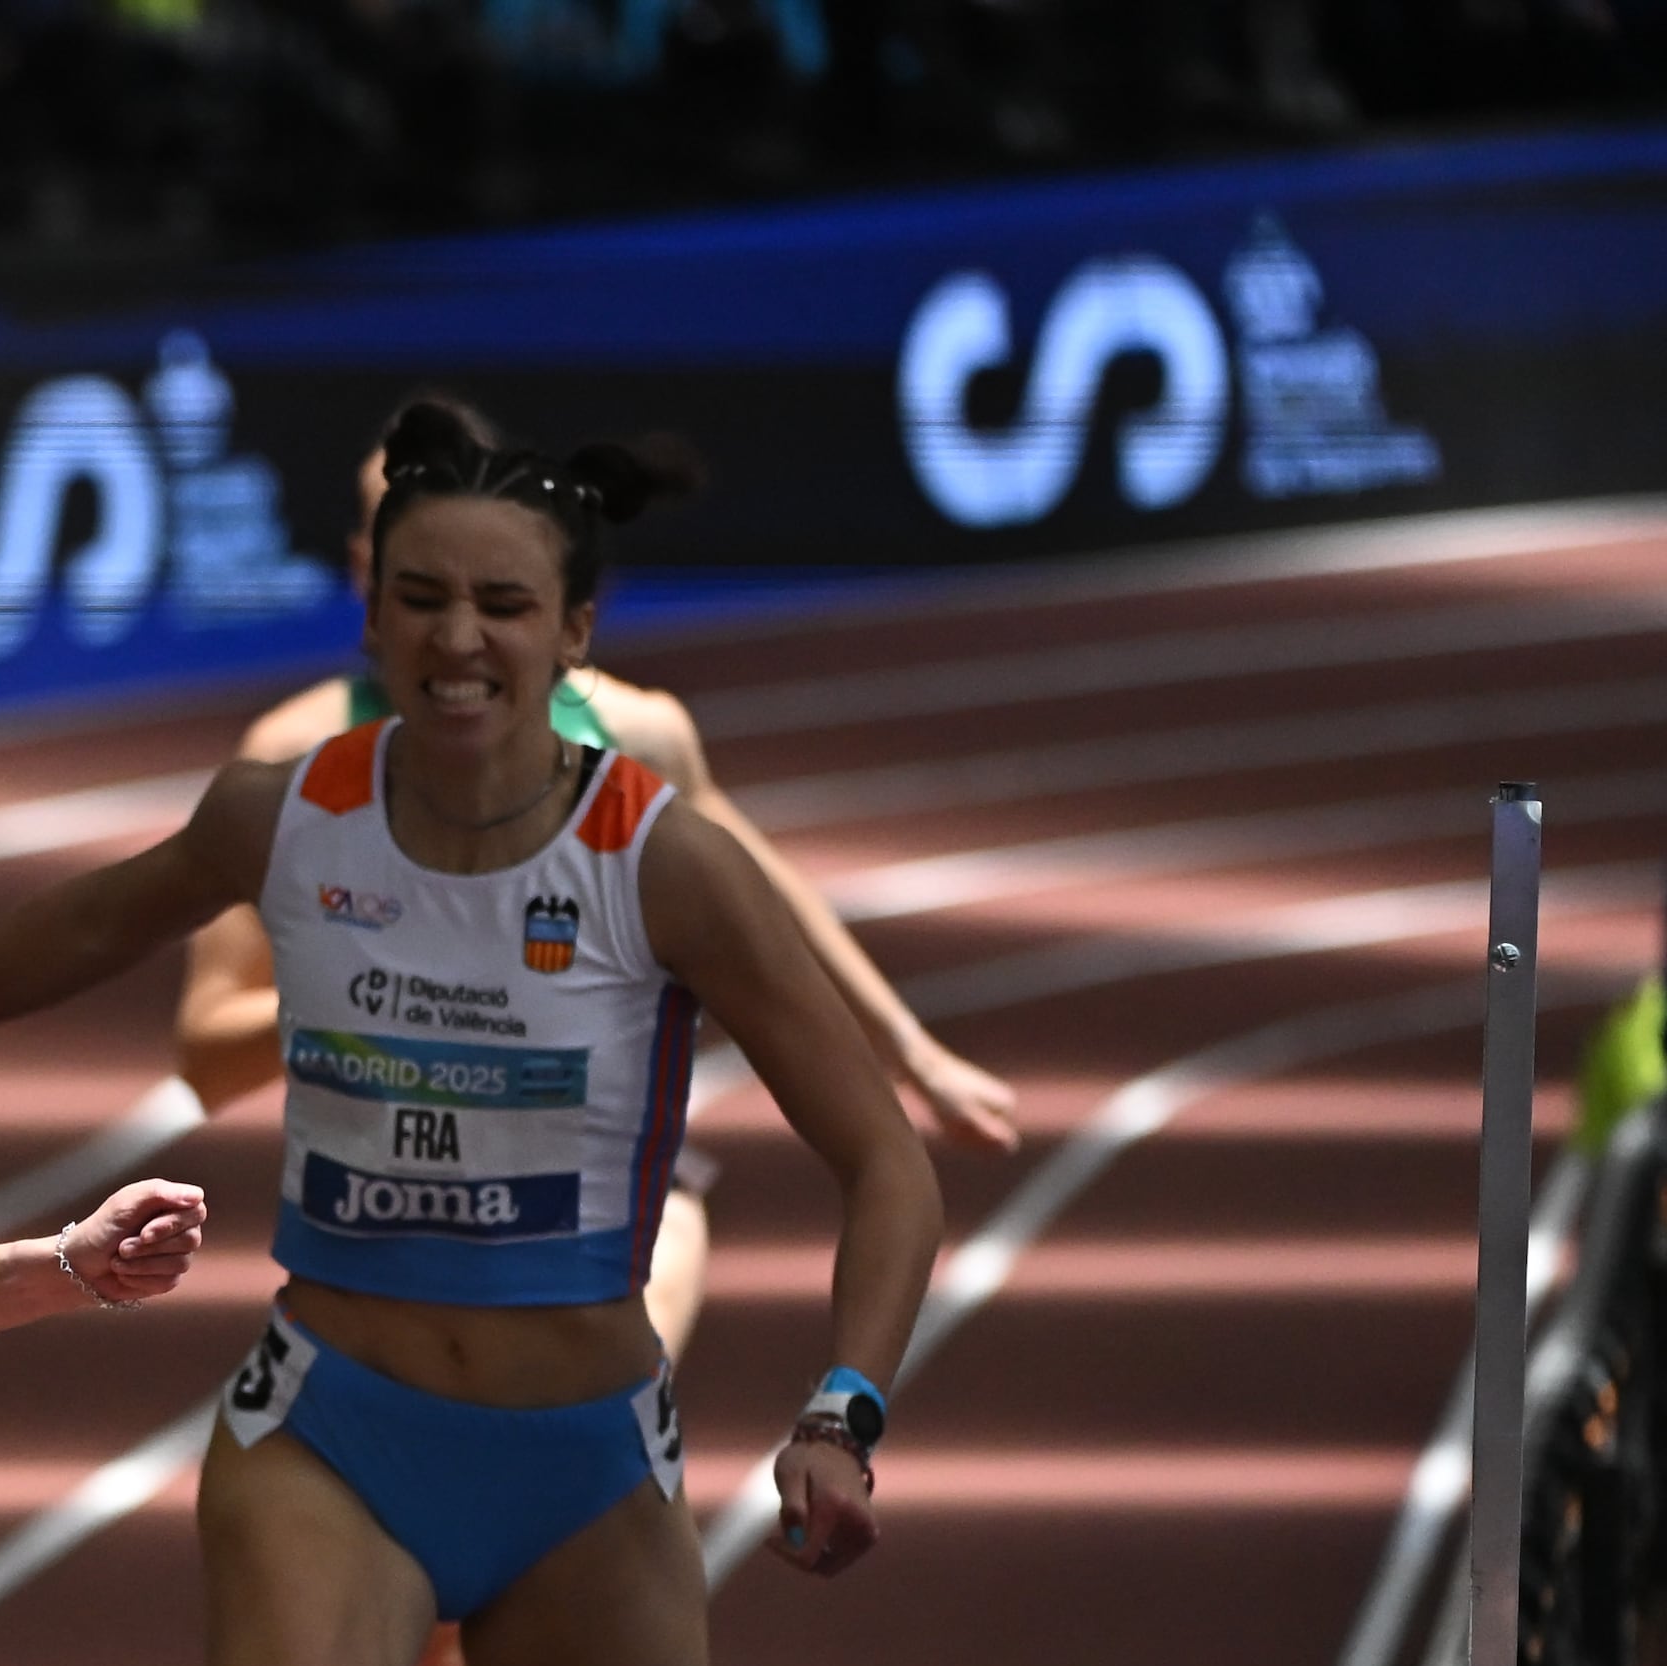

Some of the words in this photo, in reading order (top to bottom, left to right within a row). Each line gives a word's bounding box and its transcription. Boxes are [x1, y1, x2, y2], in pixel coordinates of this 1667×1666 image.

[297, 1048, 421, 1089] MADRID
[429, 1062, 507, 1095] 2025
[393, 1108, 461, 1163] FRA
[334, 1170, 520, 1226] Joma
